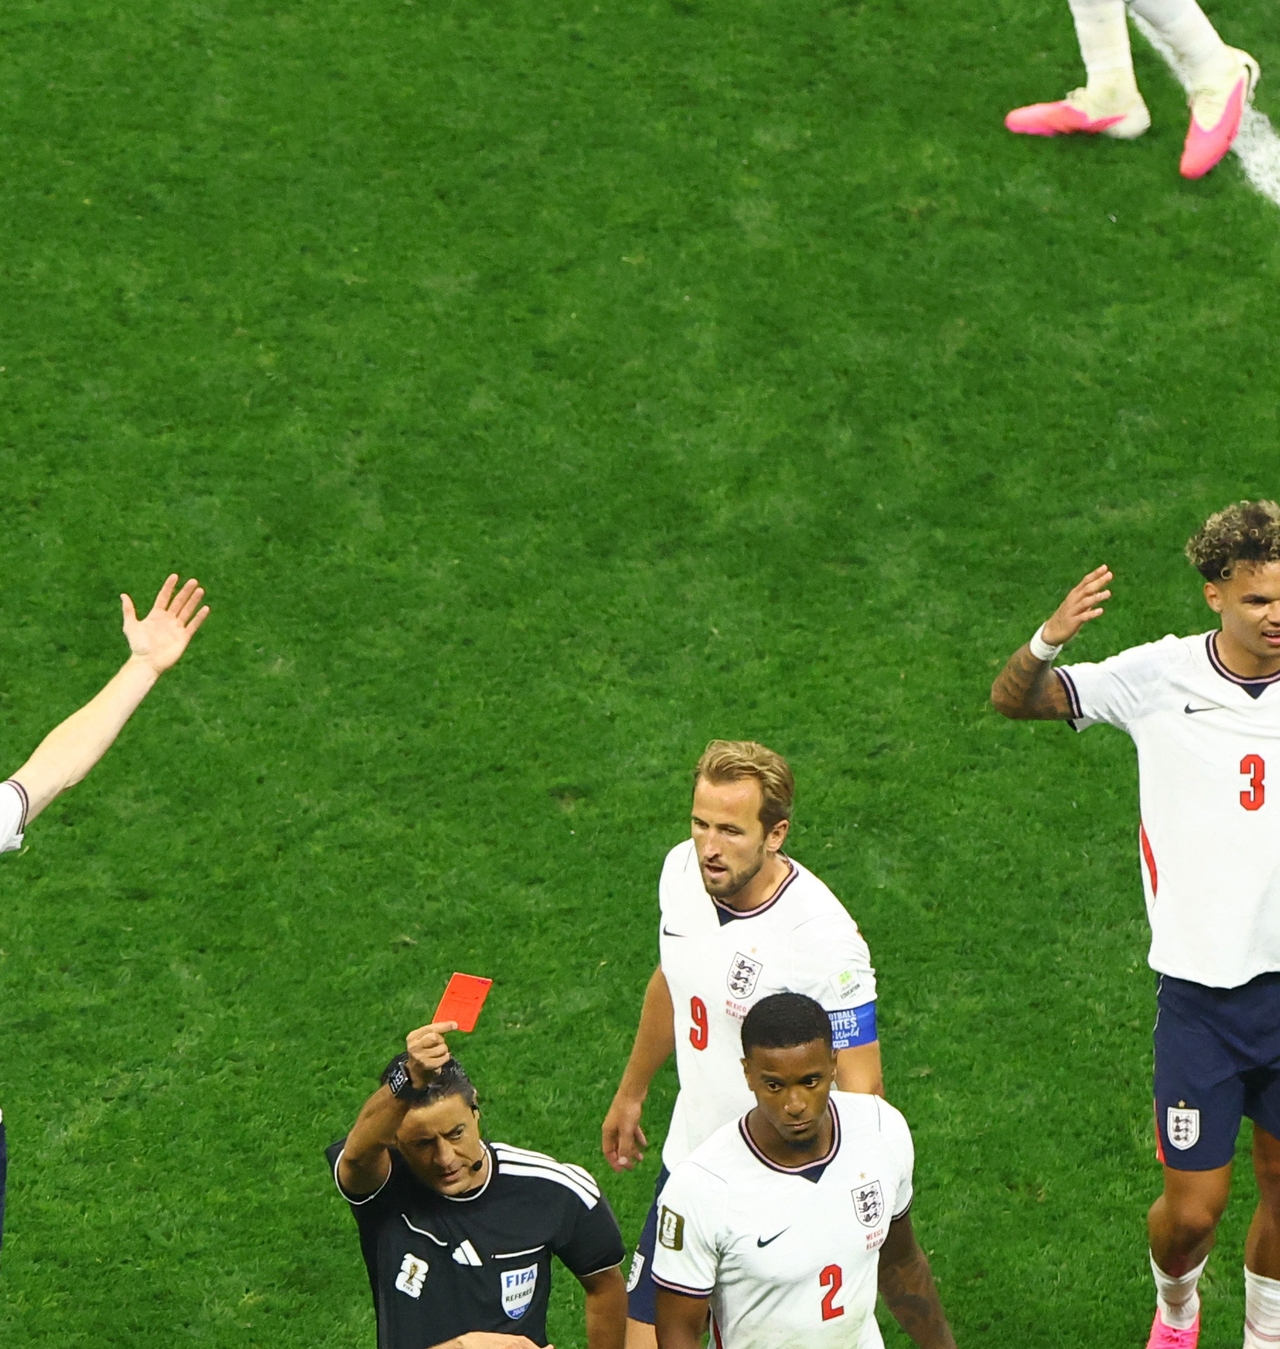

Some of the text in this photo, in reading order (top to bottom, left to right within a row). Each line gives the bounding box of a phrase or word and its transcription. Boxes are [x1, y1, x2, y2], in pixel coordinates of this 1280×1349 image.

[1240, 754, 1265, 811] 3
[725, 999, 747, 1013] MEXICO
[689, 995, 708, 1051] 9
[828, 1010, 856, 1021] OTBALL
[831, 1017, 858, 1031] ITES
[506, 1269, 536, 1288] FIFA
[505, 1287, 533, 1303] REFEREE
[819, 1264, 845, 1322] 2
